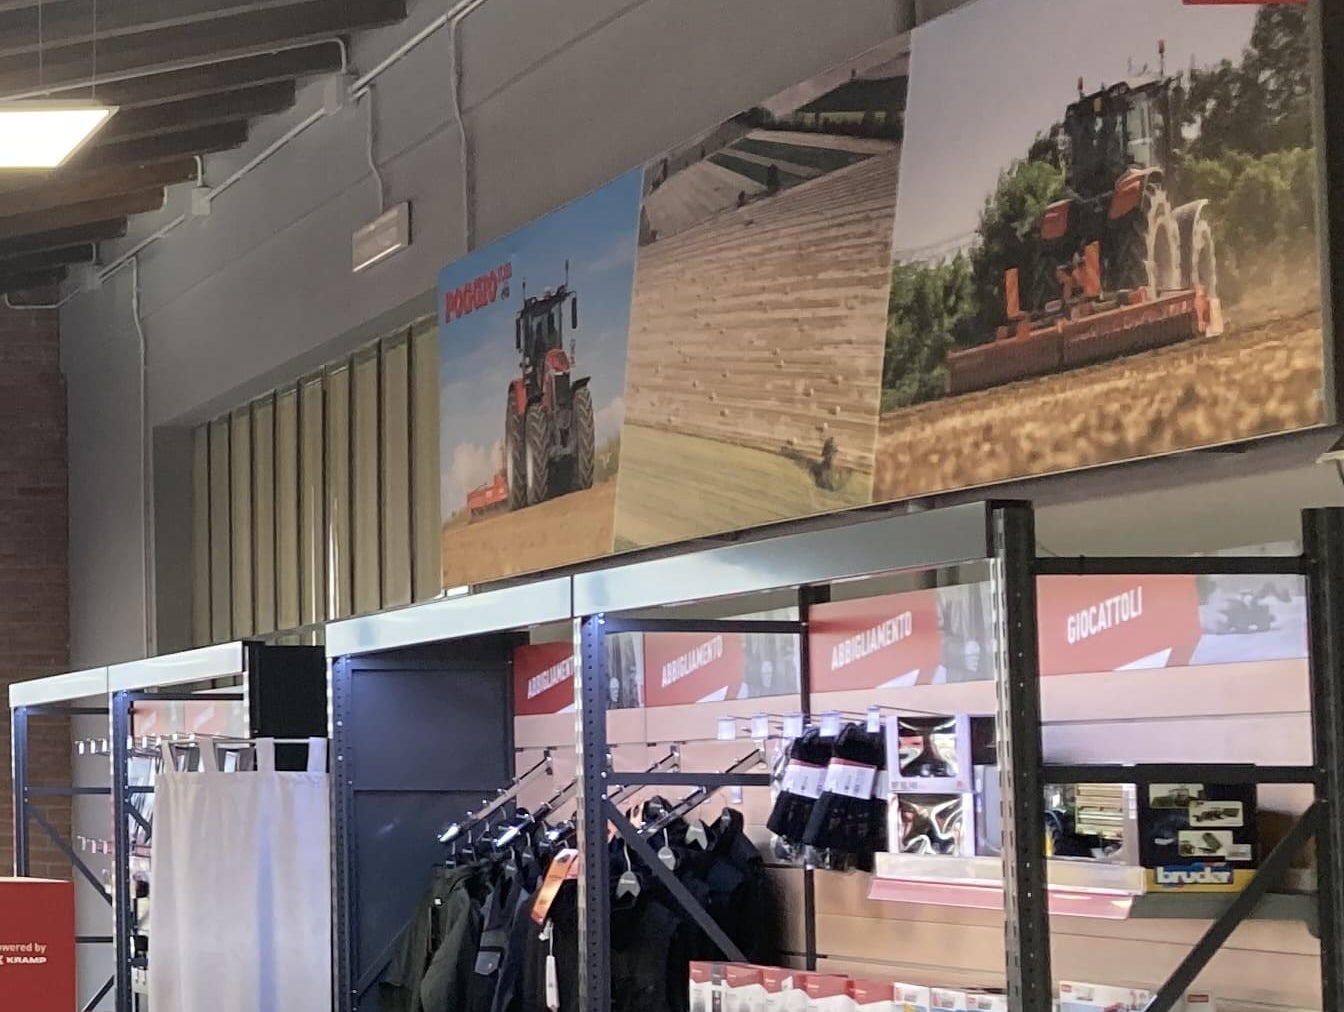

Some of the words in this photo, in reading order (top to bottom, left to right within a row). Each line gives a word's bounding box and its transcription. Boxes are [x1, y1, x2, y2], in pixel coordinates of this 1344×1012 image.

[445, 270, 498, 325] POGGIO
[831, 610, 912, 671] ABBIGLIAMENTO
[1066, 586, 1143, 645] GIOCATTOLI
[662, 634, 723, 688] ABBIGLIAMENTO
[1156, 866, 1231, 884] bruder
[6, 956, 47, 964] KRAMP
[34, 942, 47, 955] by
